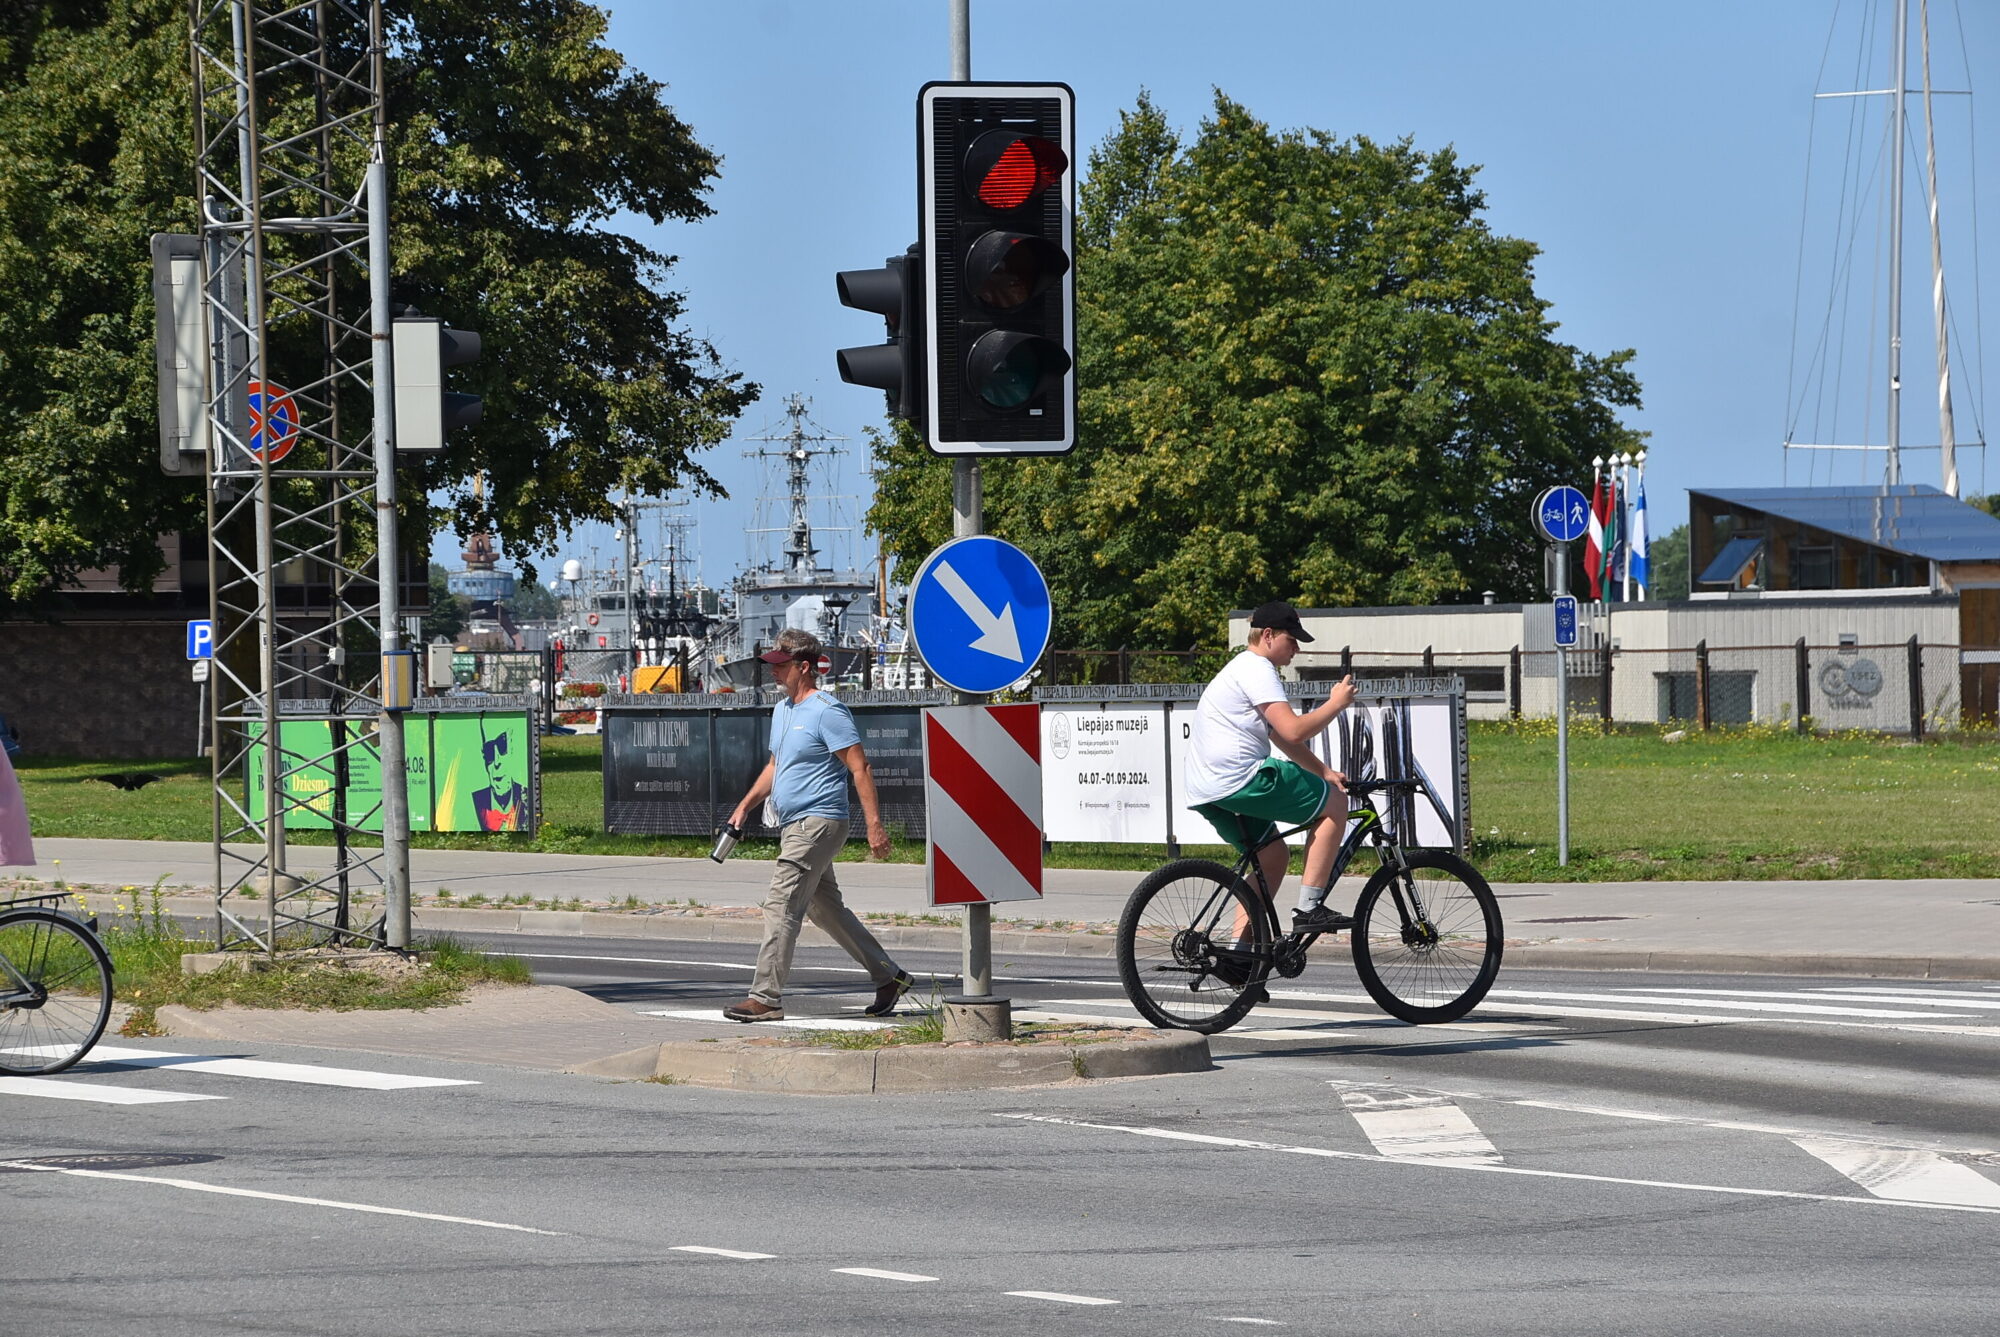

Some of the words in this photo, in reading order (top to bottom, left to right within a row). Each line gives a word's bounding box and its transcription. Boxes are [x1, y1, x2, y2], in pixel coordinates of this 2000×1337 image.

[194, 625, 211, 655] P
[1072, 685, 1111, 698] IEDVESMO
[1150, 684, 1191, 698] IEDVESMO
[659, 721, 689, 747] DZIESMA
[1077, 716, 1113, 735] Liepājas
[1116, 715, 1149, 735] muzejā
[292, 774, 329, 792] Dziesma
